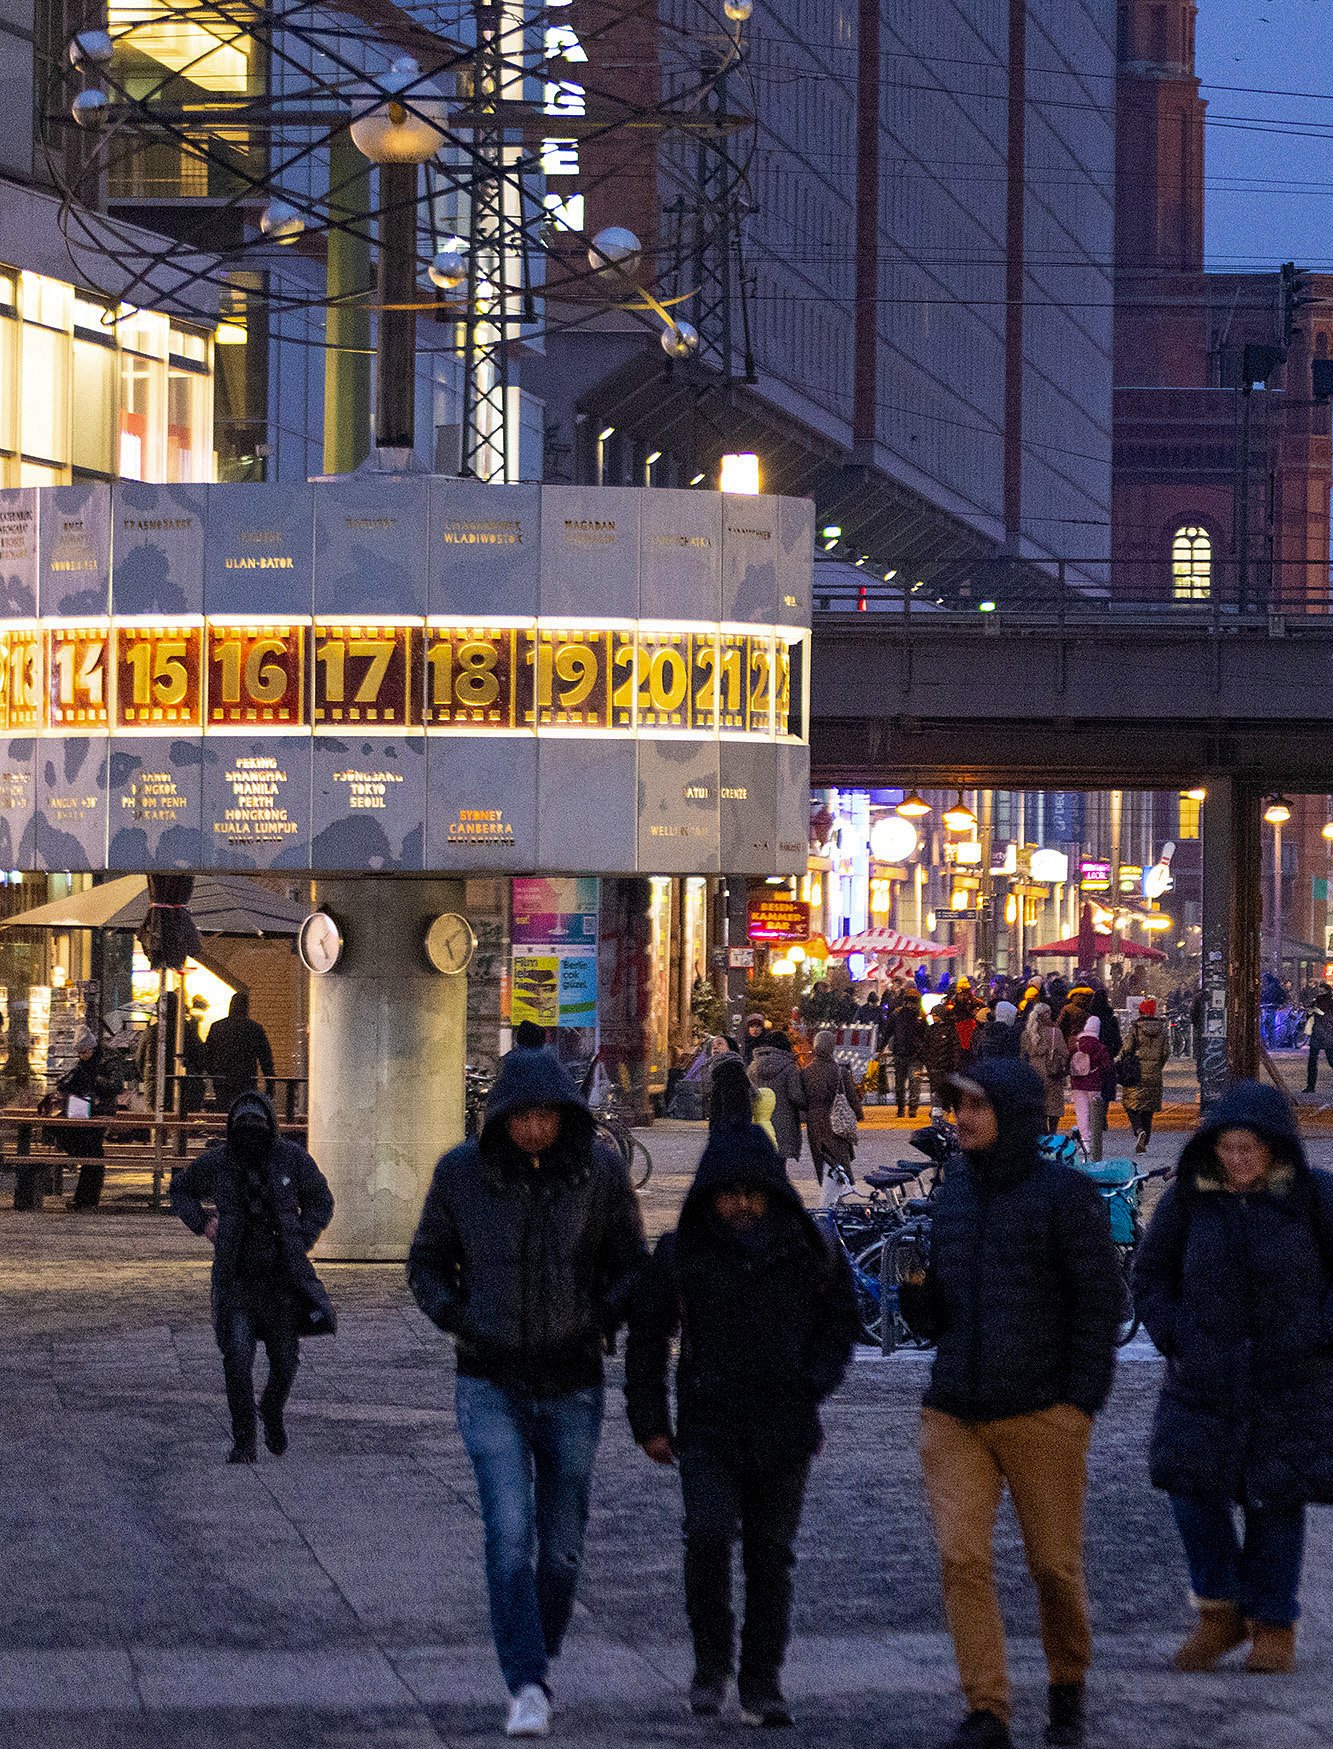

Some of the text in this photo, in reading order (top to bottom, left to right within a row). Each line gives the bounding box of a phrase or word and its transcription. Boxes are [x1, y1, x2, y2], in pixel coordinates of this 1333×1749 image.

[541, 0, 589, 232] AGEN
[225, 556, 294, 569] ULAN-BATOR
[55, 643, 104, 704] 14
[125, 642, 189, 705] 15
[212, 640, 289, 704] 16
[316, 641, 398, 703] 17
[427, 642, 499, 707] 18
[525, 644, 599, 708] 19
[613, 645, 688, 711] 20
[695, 647, 741, 711] 21
[131, 784, 178, 796] BNGKOK
[232, 782, 280, 795] MANILA
[349, 783, 386, 795] TOKYO
[121, 797, 188, 809] PHOM PENH
[238, 796, 275, 808] PERTH
[350, 796, 387, 808] SEOUL
[225, 809, 288, 821] HONGKONG
[459, 809, 503, 821] SYDNEY
[213, 822, 299, 834] KUALA LUMPUR
[449, 823, 513, 834] CANBERRA
[766, 921, 791, 931] BAR
